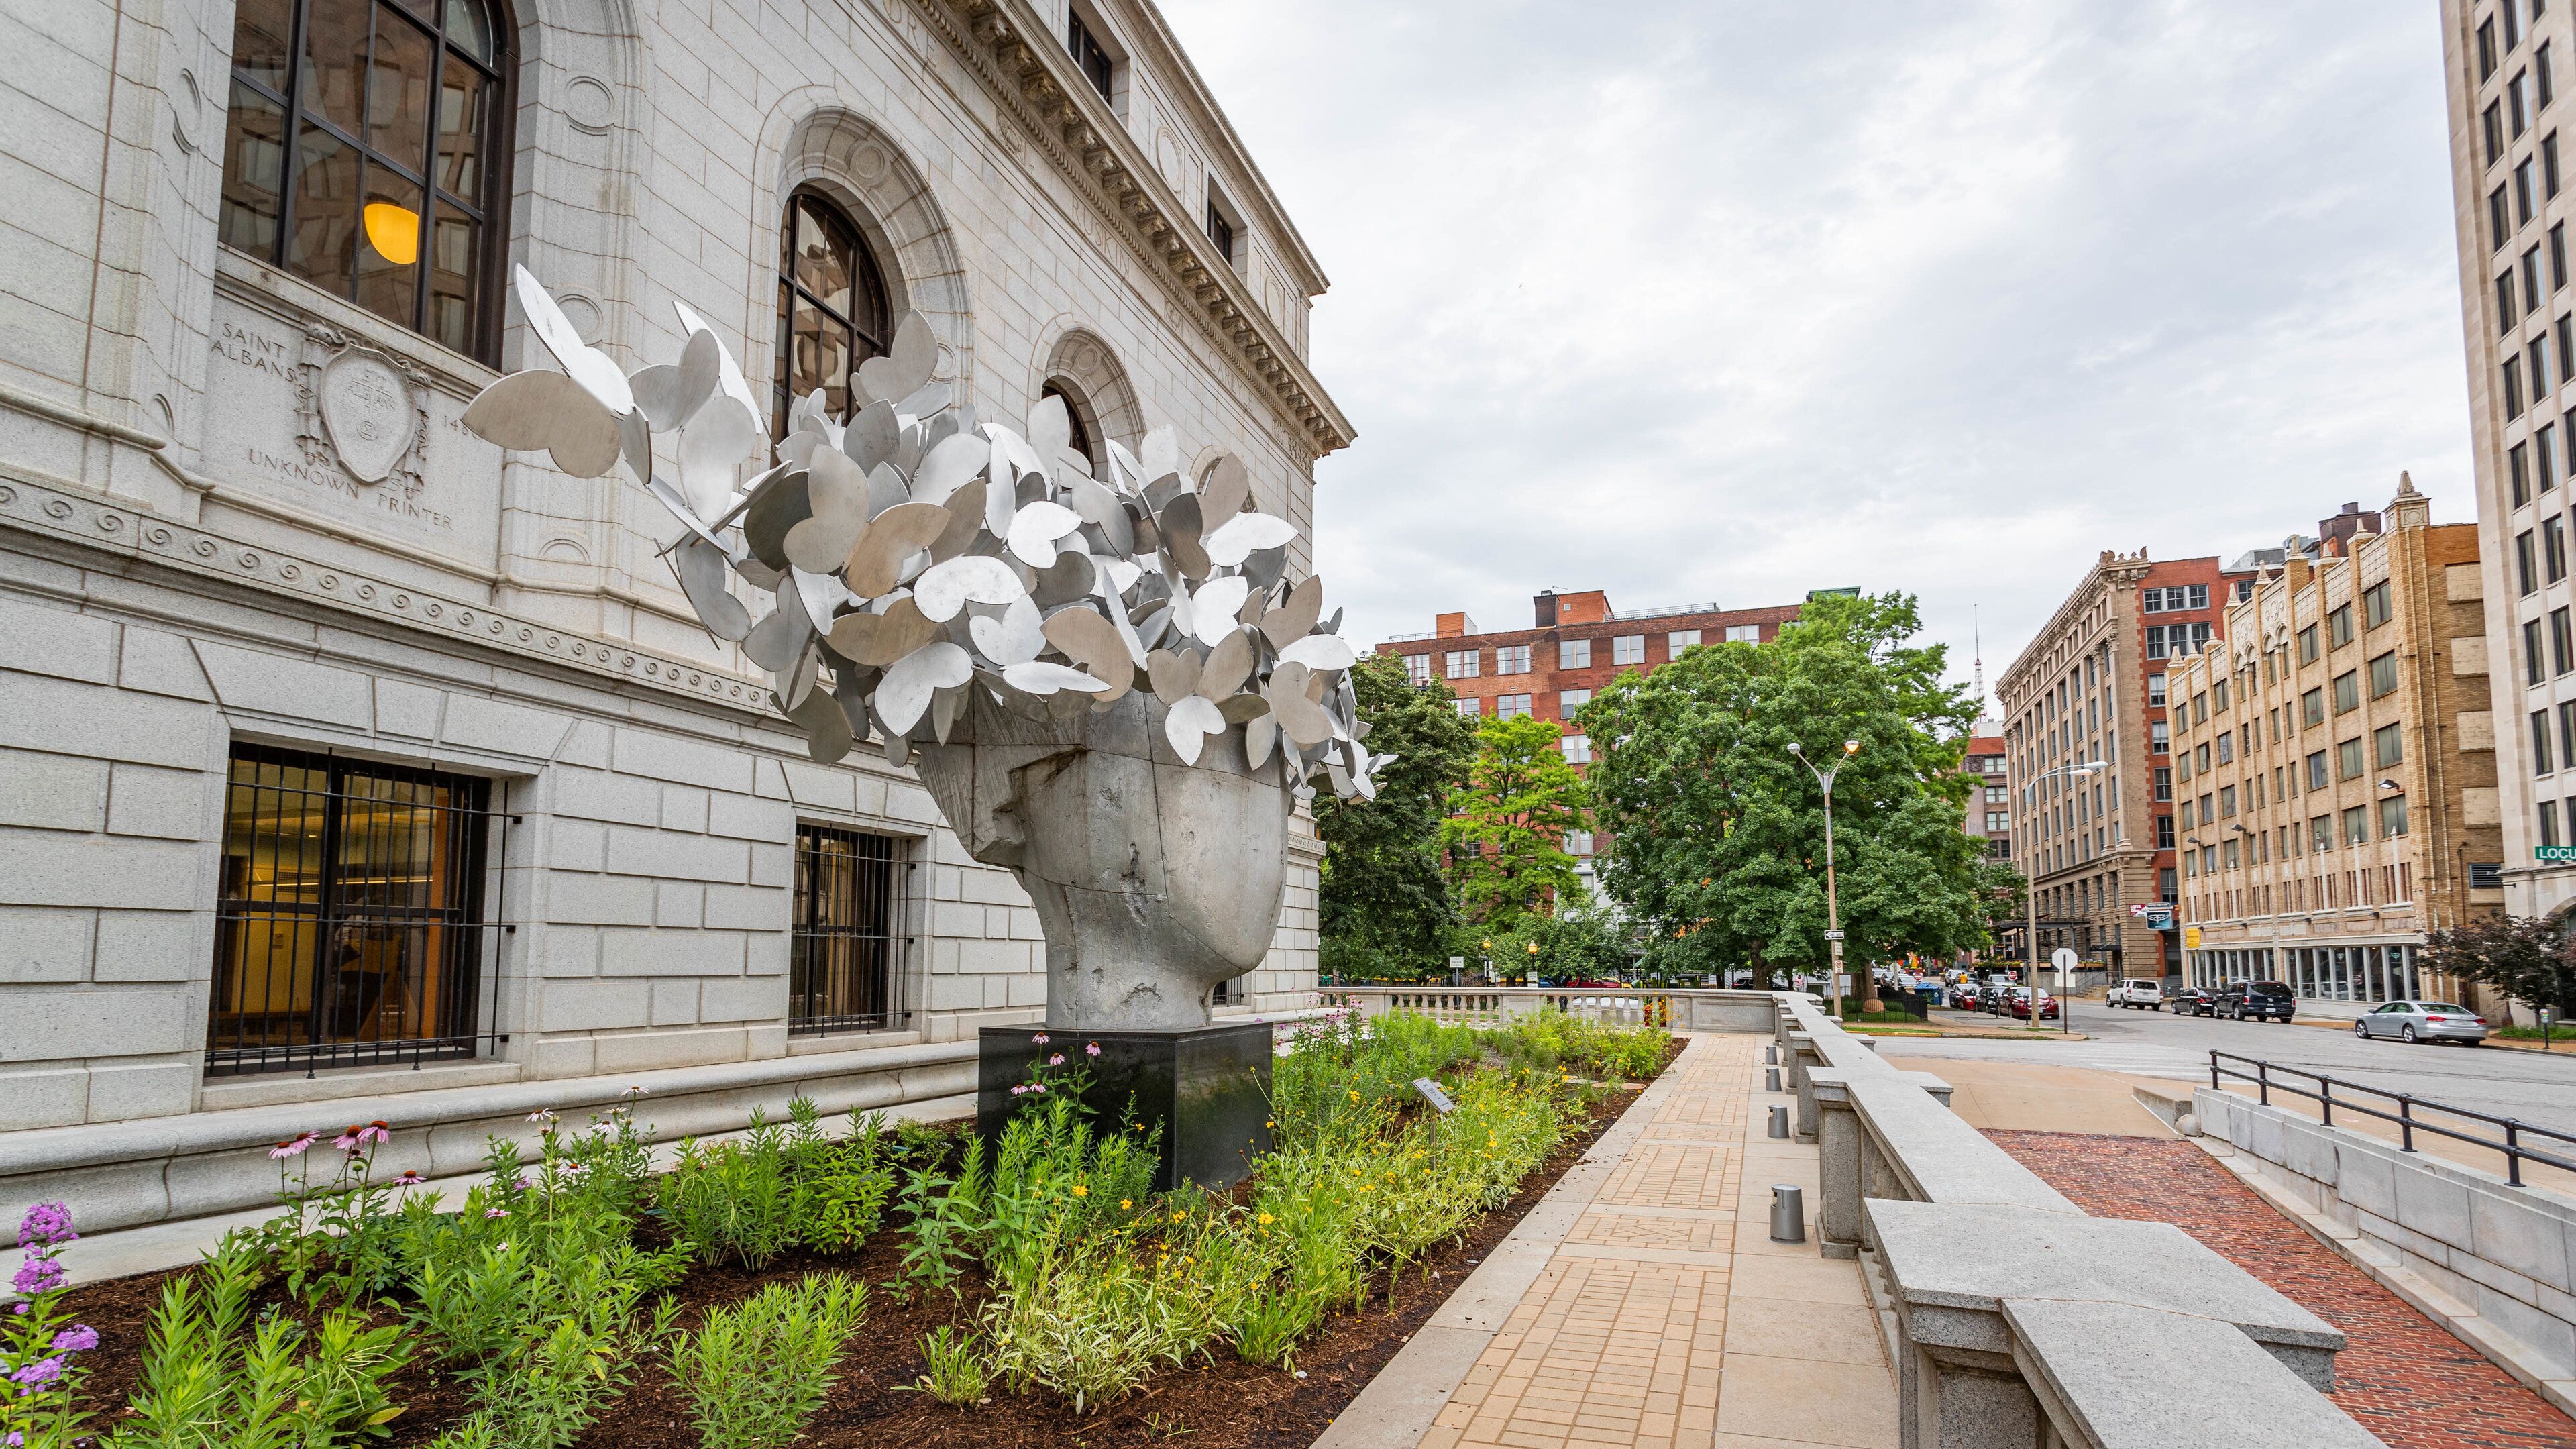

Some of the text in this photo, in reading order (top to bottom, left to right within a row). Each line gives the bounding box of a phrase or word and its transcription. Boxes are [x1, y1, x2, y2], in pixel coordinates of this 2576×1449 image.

[1072, 194, 1130, 277] RUSKIN
[211, 340, 295, 382] ALBANS
[222, 323, 285, 358] SAINT
[1208, 350, 1253, 412] CARLYLE
[250, 449, 359, 499] UNKNOWN
[378, 493, 453, 531] PRINTER
[2539, 847, 2576, 859] LOCU
